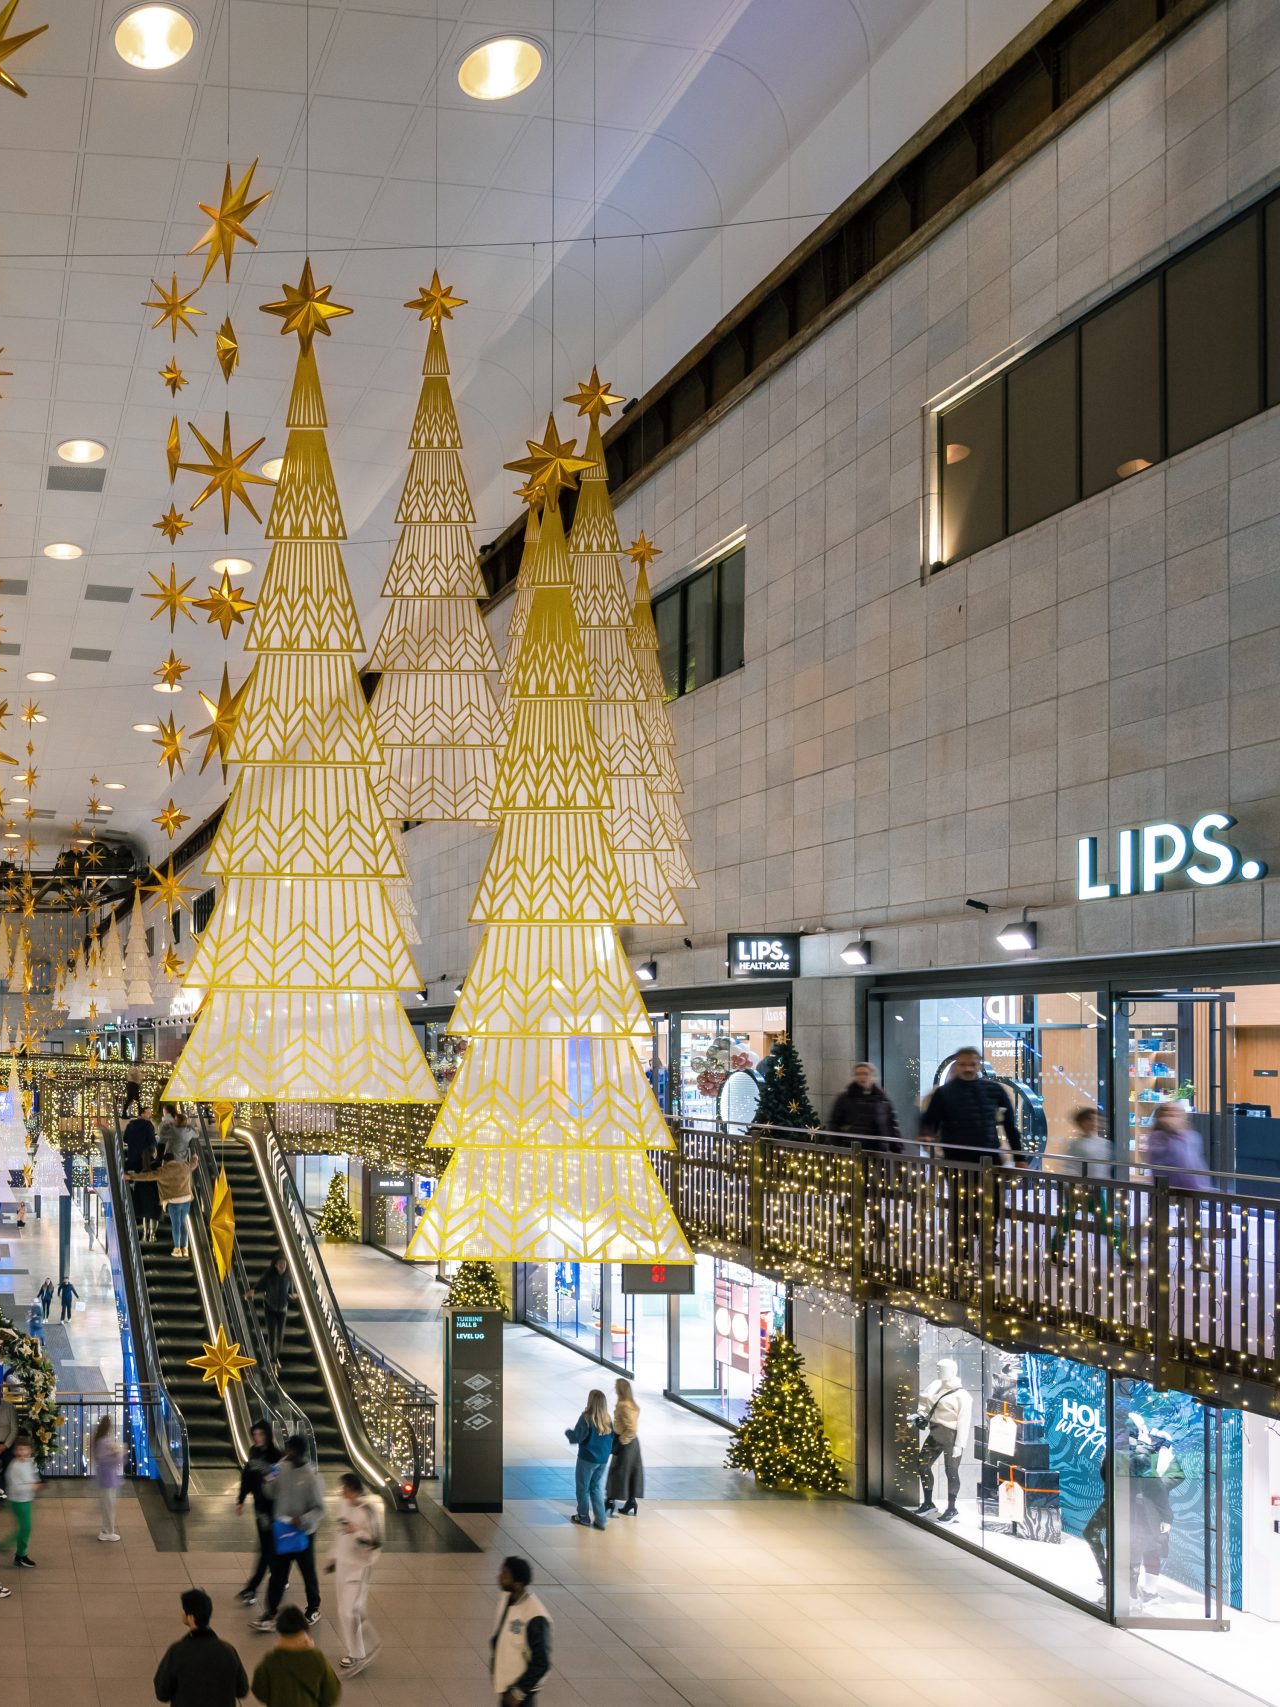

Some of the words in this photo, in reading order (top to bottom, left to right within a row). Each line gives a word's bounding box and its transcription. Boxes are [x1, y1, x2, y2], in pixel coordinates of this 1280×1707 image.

[1078, 814, 1264, 900] LIPS.
[738, 940, 790, 961] LIPS.
[739, 962, 790, 970] HEALTHCARE
